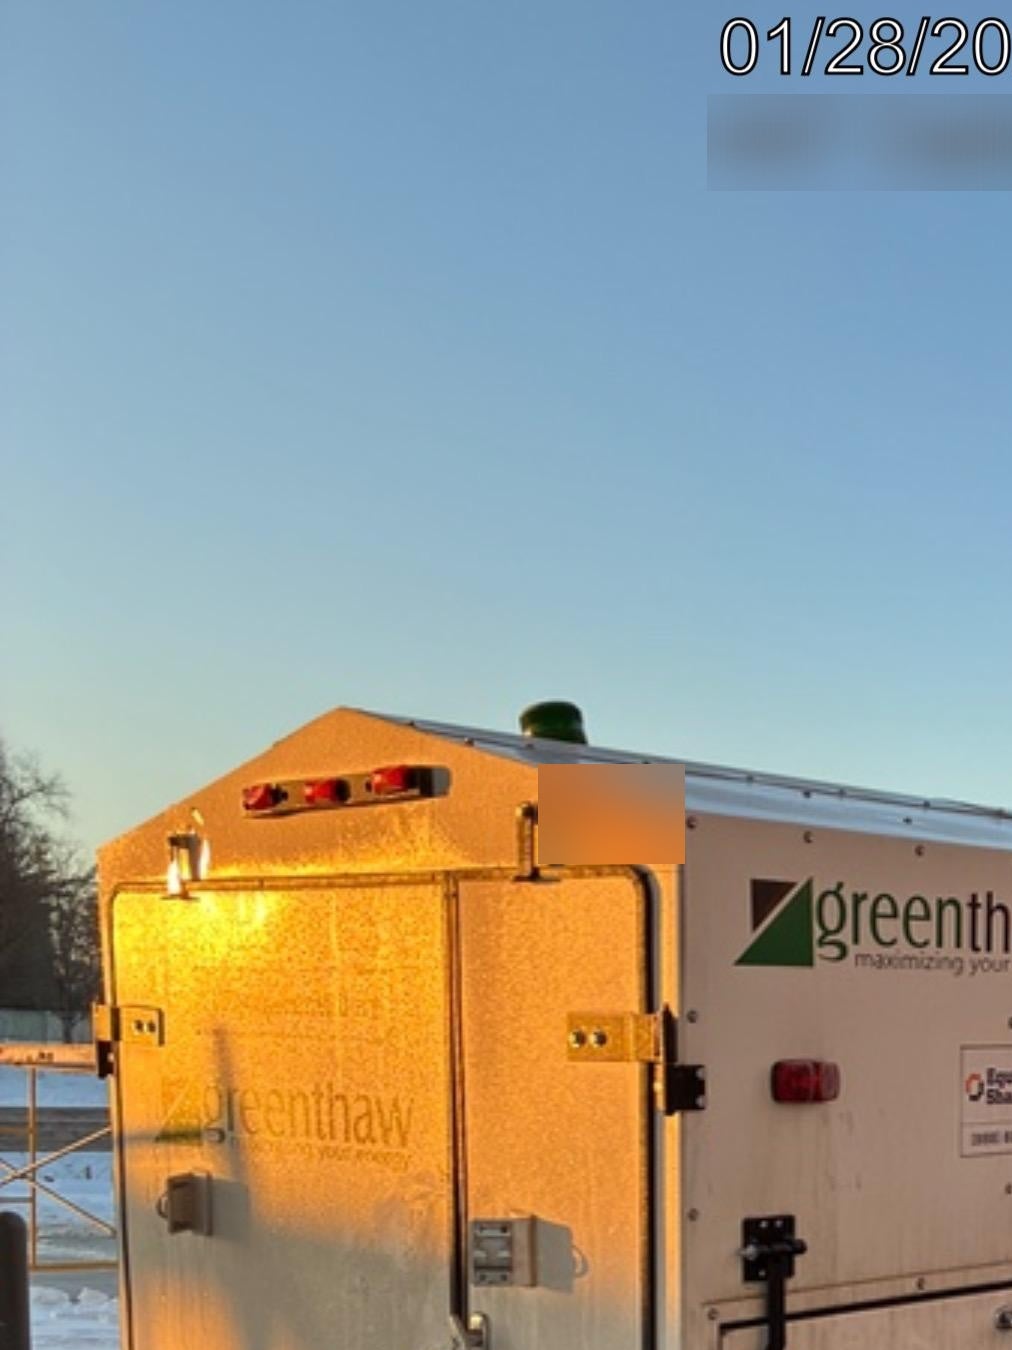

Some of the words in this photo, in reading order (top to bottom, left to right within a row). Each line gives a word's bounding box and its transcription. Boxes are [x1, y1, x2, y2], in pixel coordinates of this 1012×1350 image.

[854, 951, 964, 976] maximizing
[968, 956, 1011, 976] your
[202, 1080, 414, 1147] greenthaw
